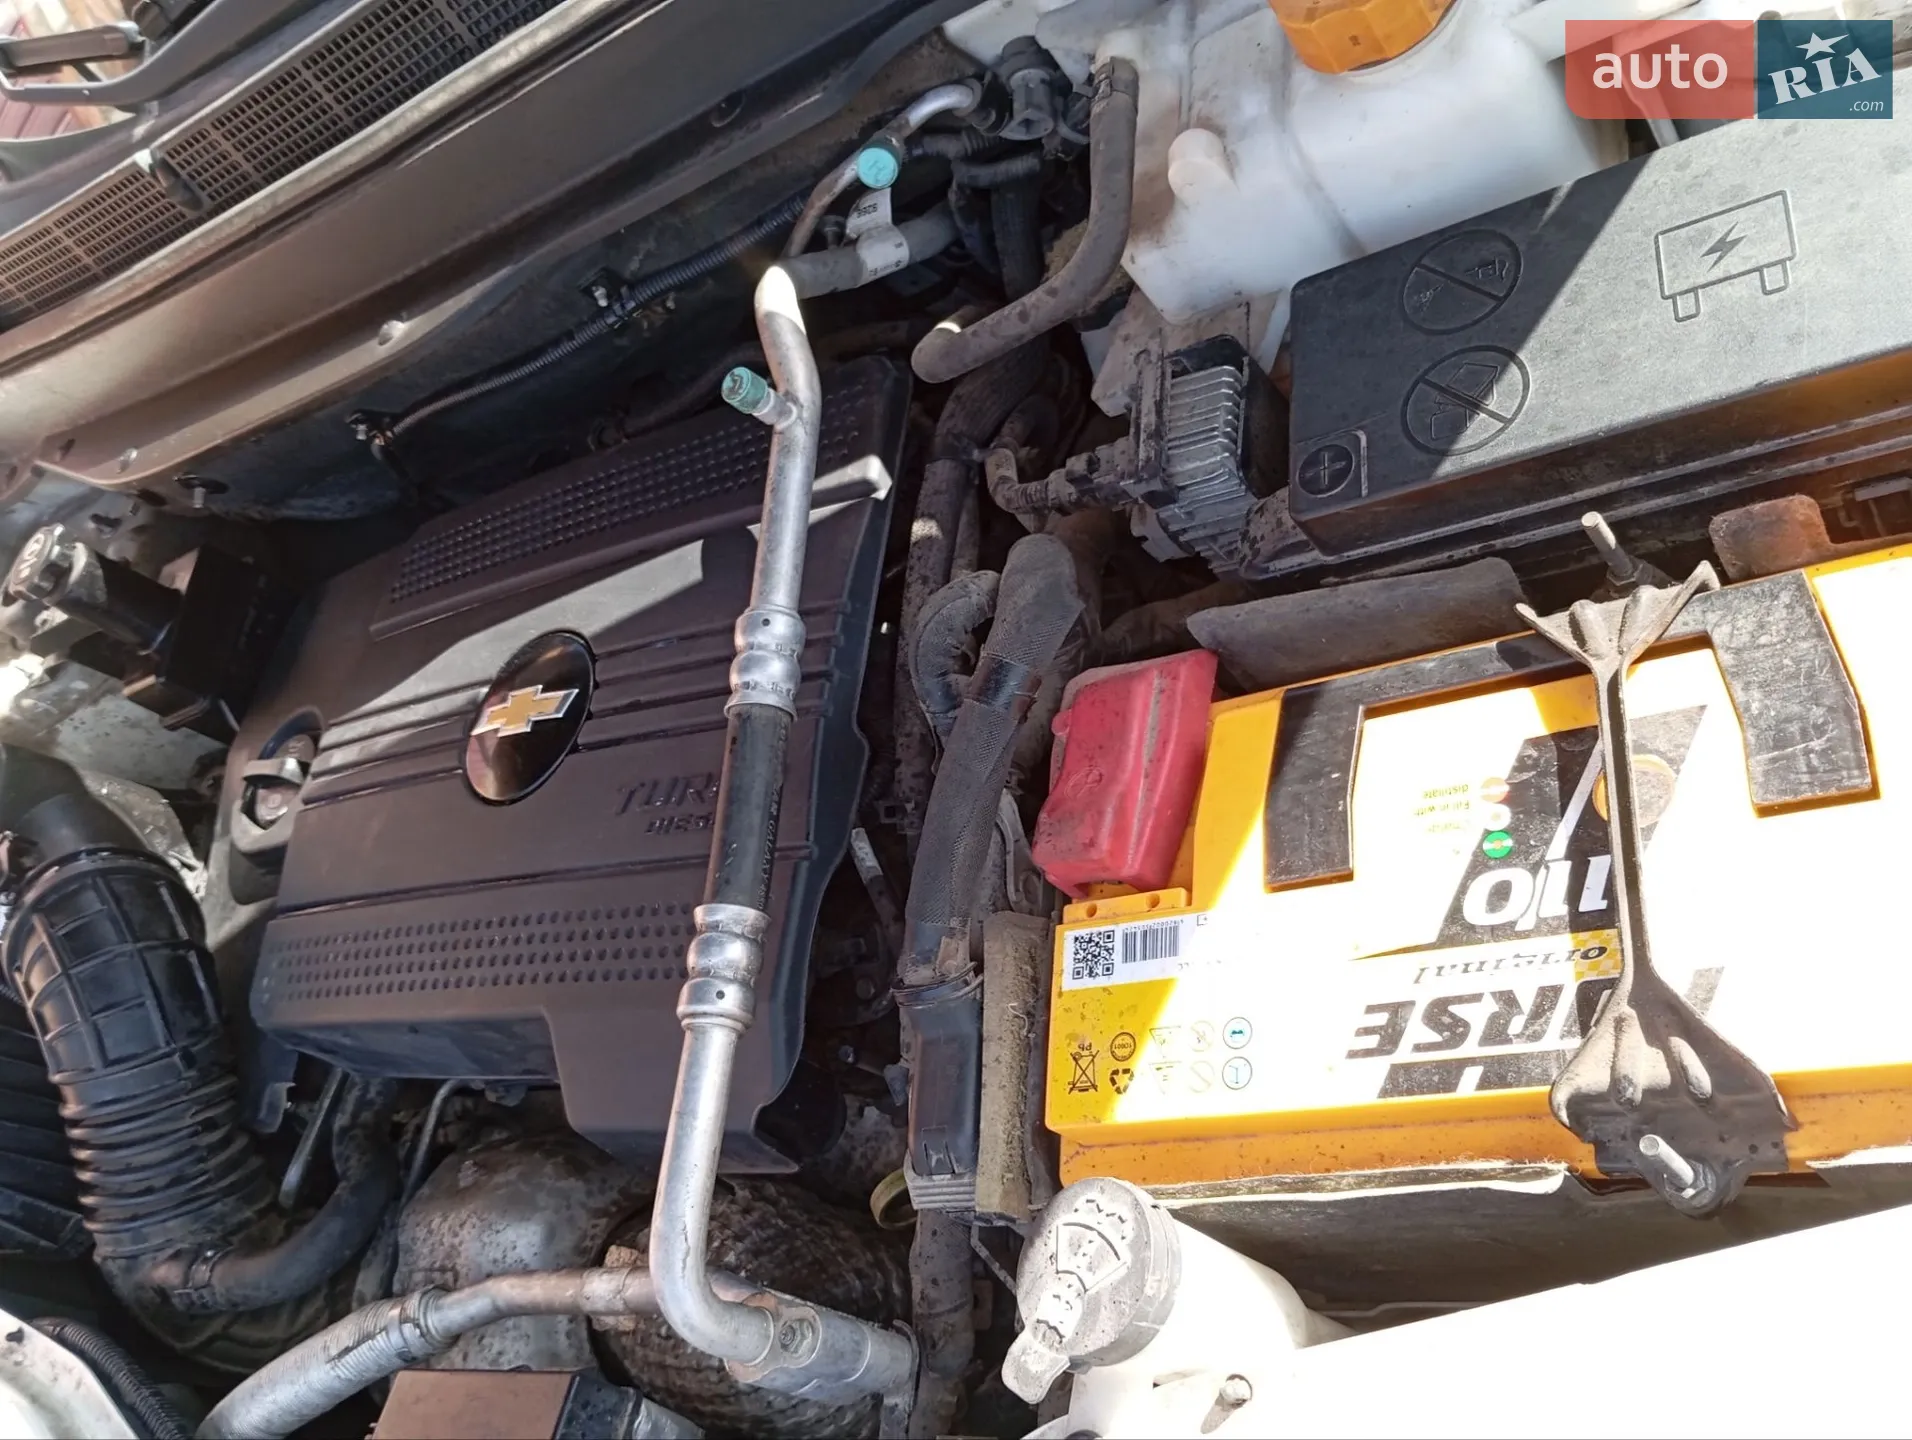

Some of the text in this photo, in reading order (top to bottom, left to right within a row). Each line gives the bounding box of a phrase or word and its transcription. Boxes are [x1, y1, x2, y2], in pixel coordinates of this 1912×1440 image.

[615, 771, 720, 816] TUR
[1413, 946, 1608, 985] original
[1077, 1041, 1093, 1052] Pb
